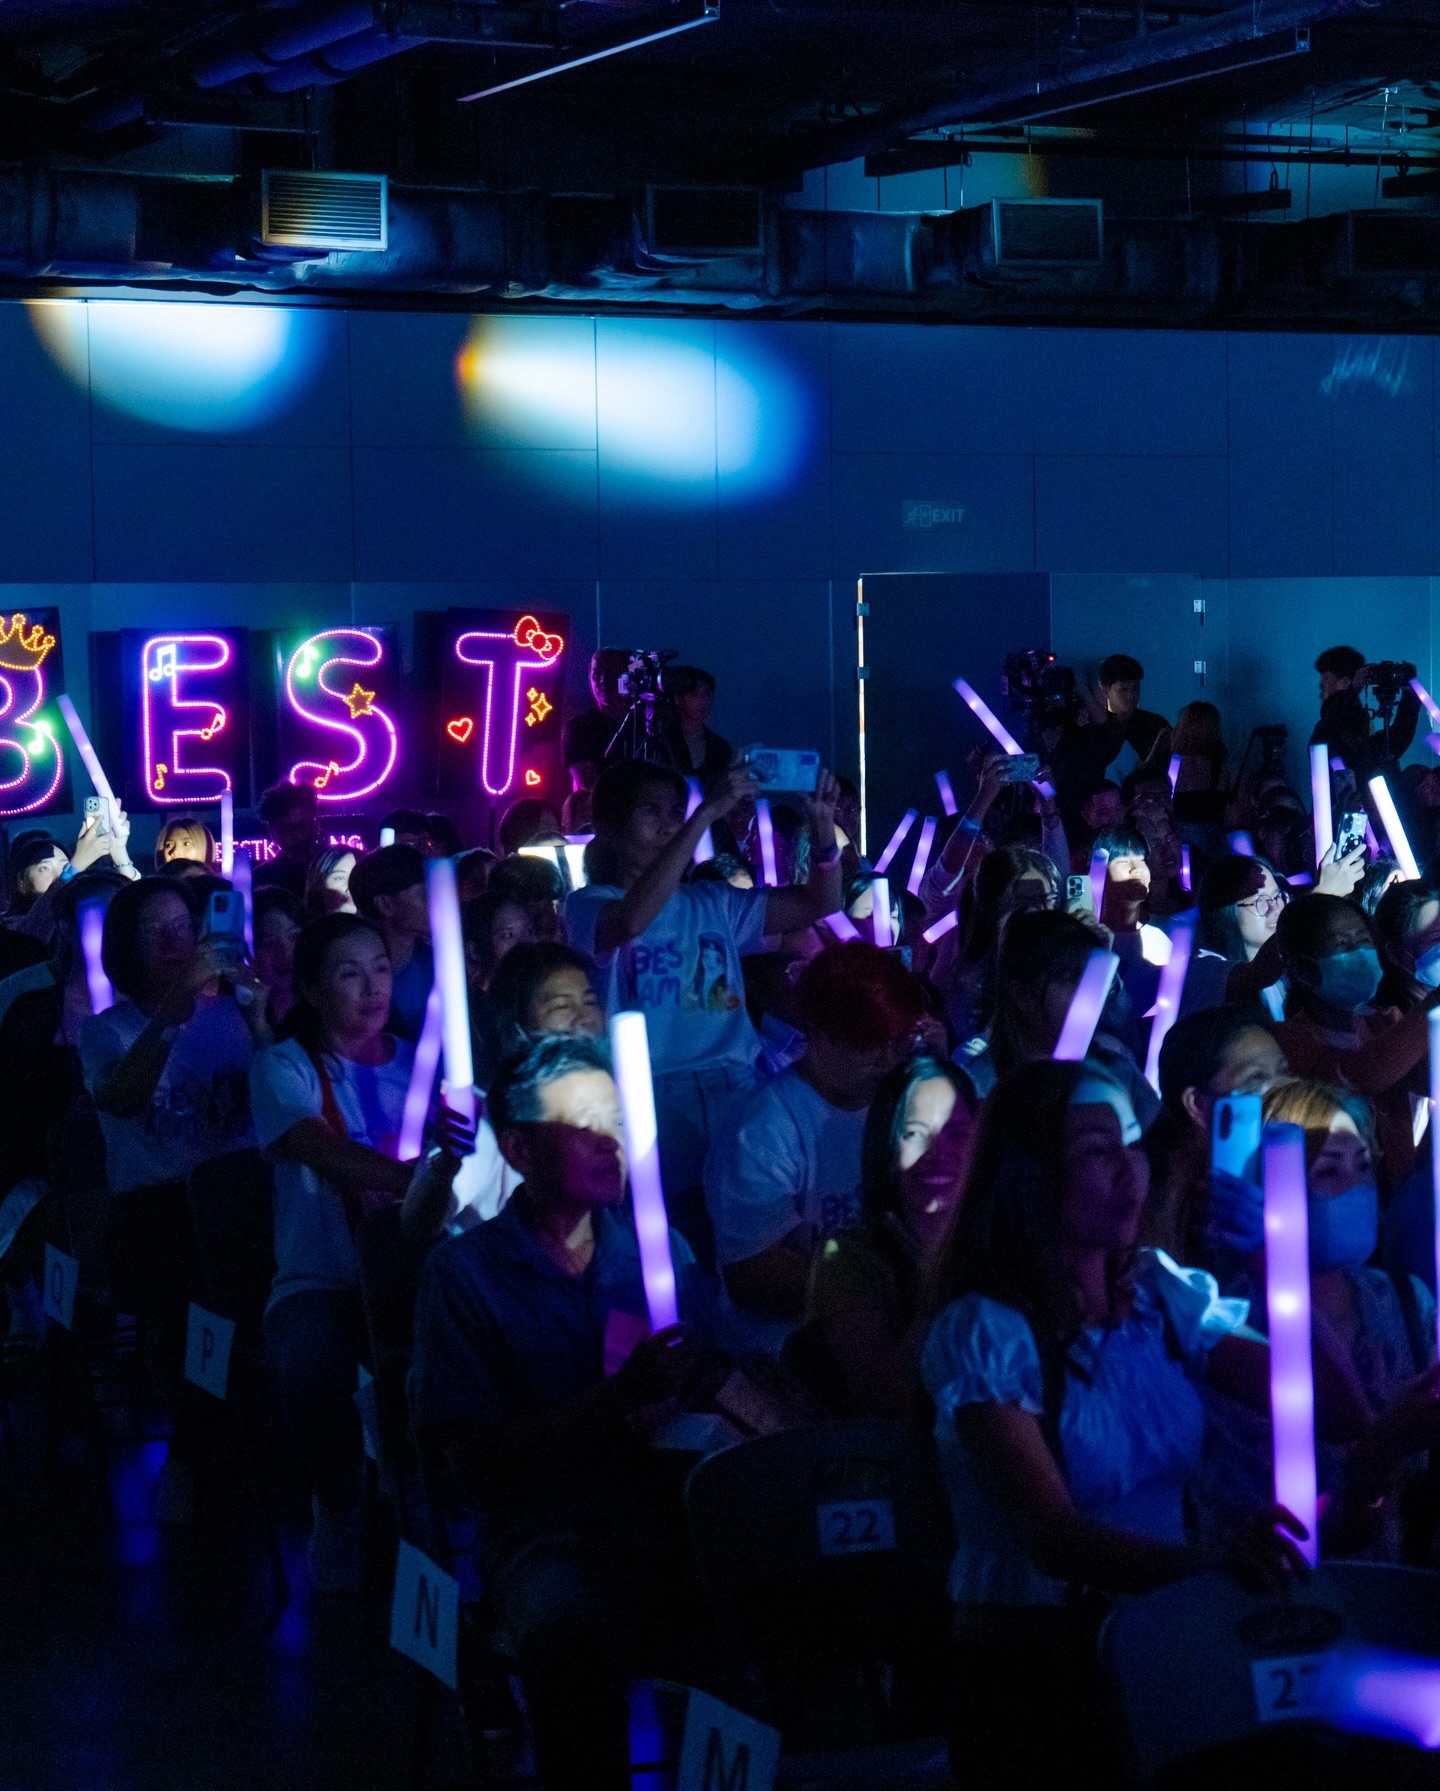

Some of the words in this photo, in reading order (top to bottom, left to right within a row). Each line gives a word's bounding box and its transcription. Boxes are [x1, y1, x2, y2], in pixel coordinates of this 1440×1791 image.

[932, 508, 964, 523] EXIT
[0, 629, 560, 815] BEST
[202, 1325, 214, 1373] P
[831, 1509, 880, 1544] 22
[415, 1574, 439, 1649] N
[703, 1726, 751, 1791] M
